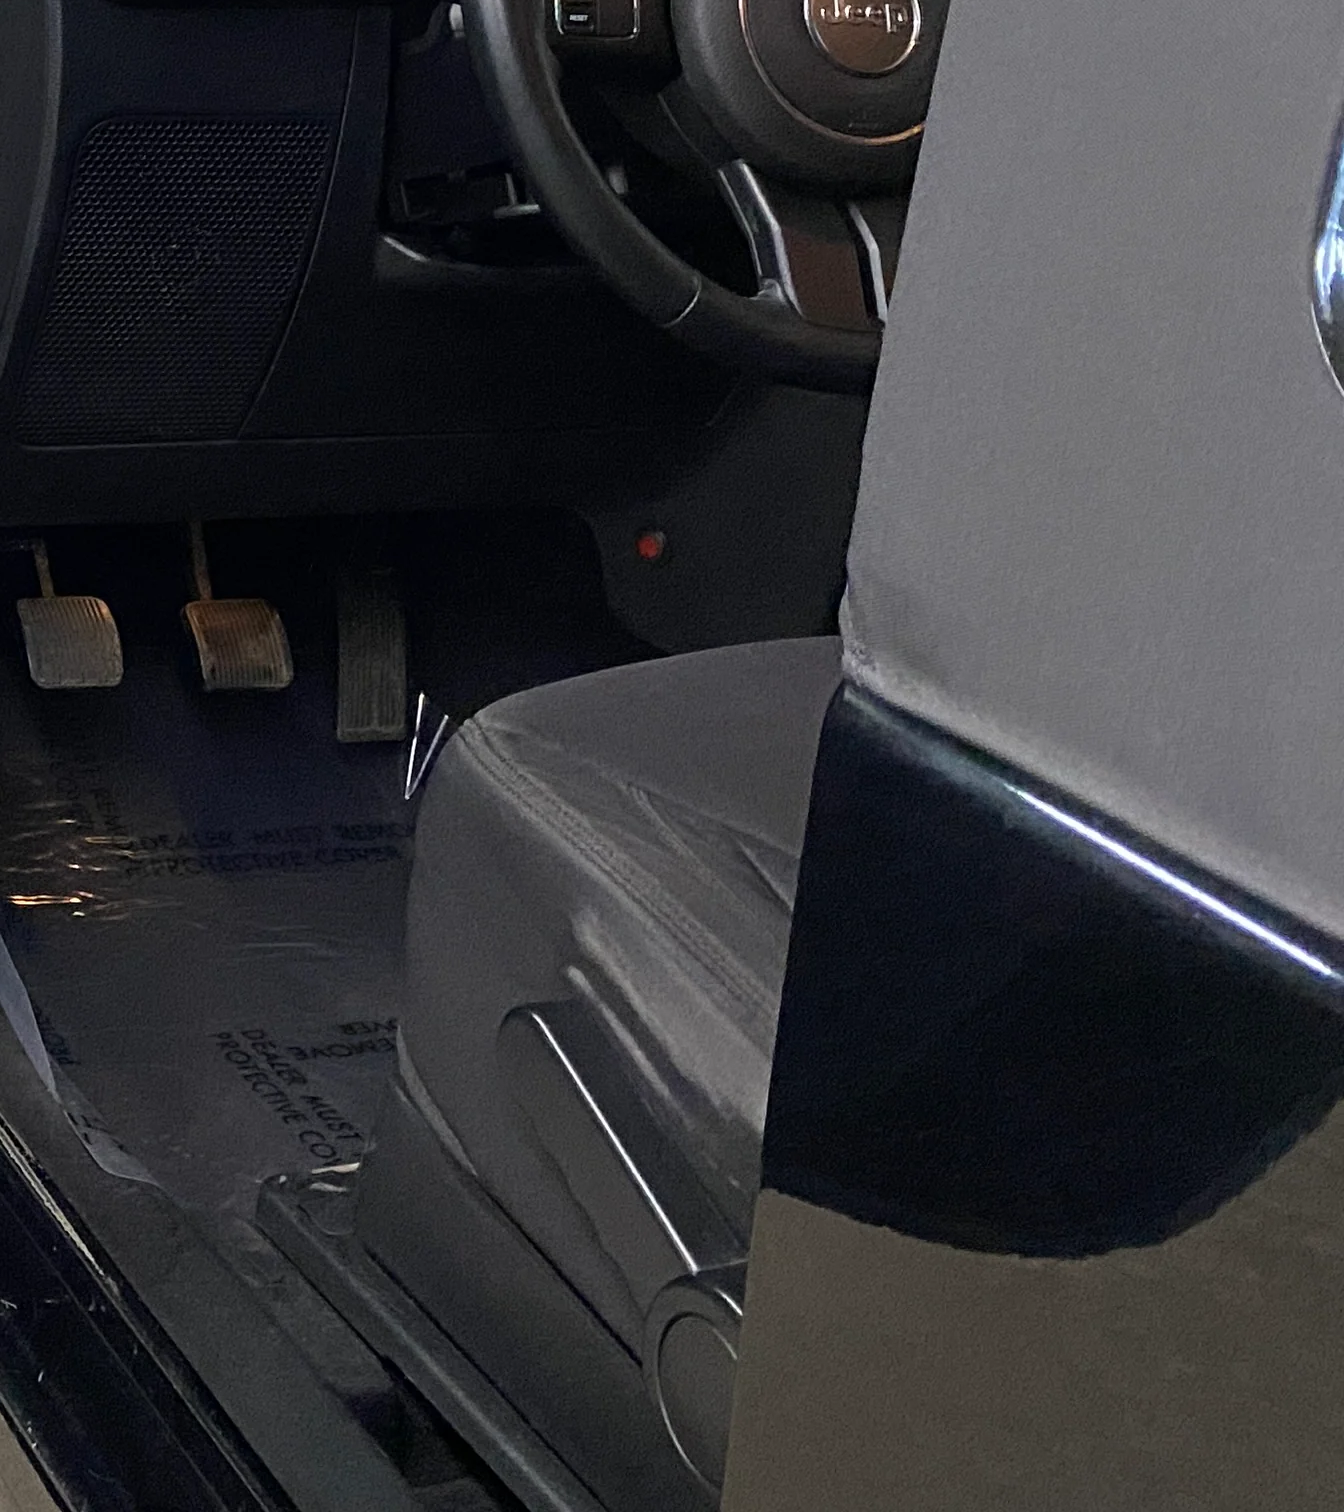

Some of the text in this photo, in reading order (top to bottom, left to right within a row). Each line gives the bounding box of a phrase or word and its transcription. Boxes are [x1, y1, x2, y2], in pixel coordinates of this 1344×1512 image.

[208, 1032, 307, 1124] PROTECTIVE
[241, 1029, 363, 1141] DEALER MUST
[287, 1037, 397, 1060] EMOVE
